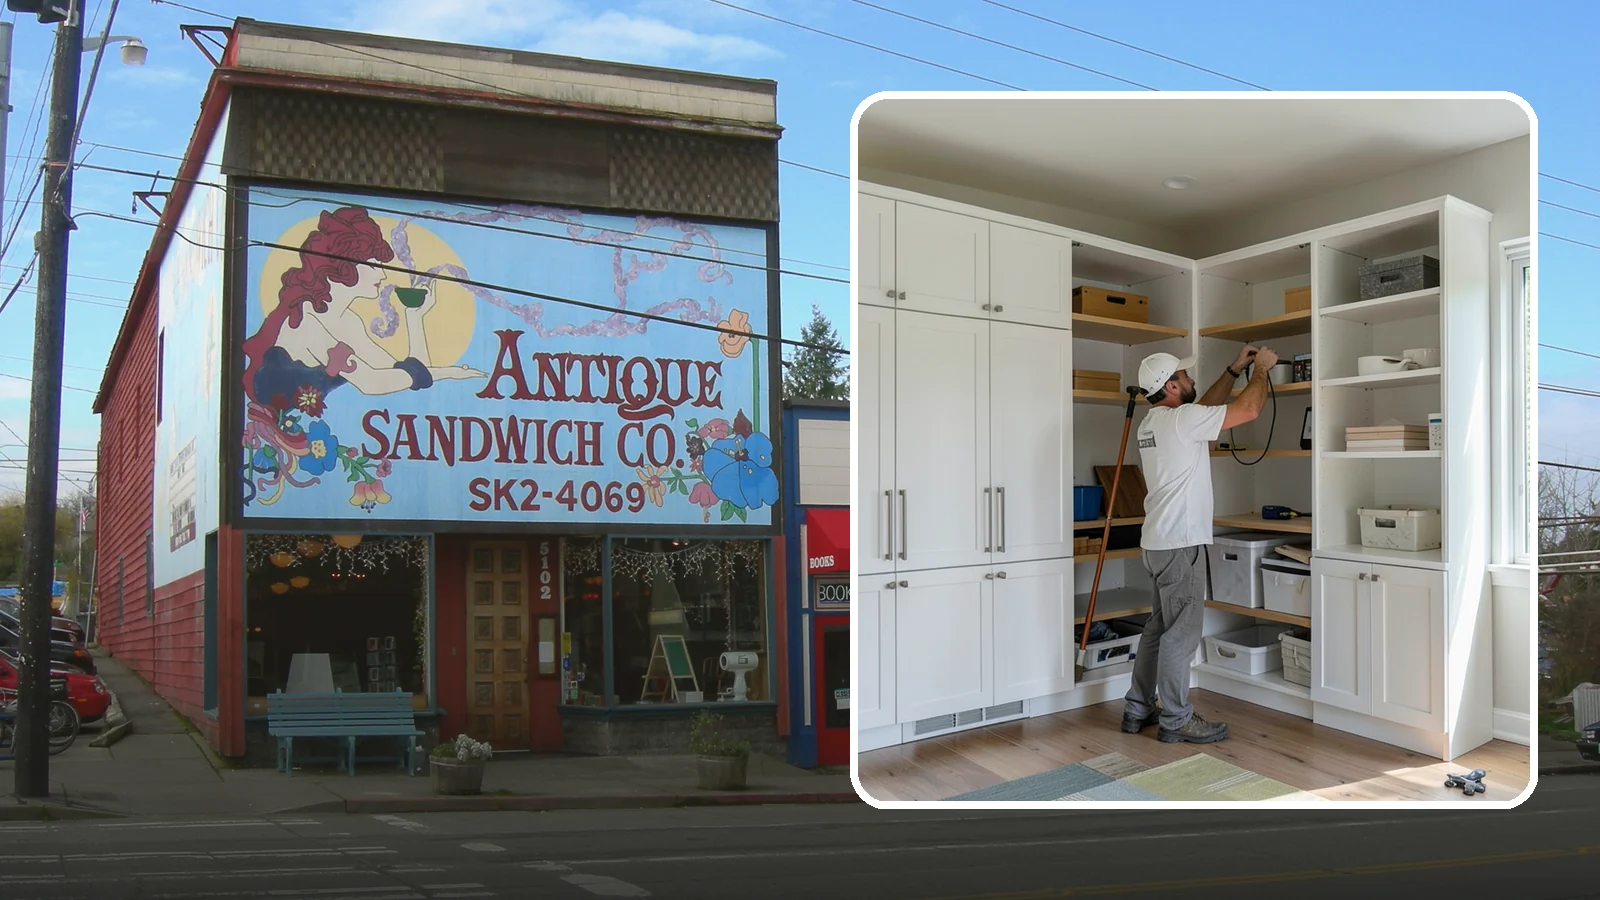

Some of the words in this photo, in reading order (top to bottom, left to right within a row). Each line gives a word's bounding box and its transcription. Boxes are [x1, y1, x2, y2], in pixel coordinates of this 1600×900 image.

[475, 328, 724, 421] ANTIQUE
[361, 408, 605, 467] SANDWICH
[617, 422, 685, 468] CO.
[468, 477, 646, 513] SK2-4069
[540, 542, 552, 600] 5102
[809, 555, 835, 569] BOOKS
